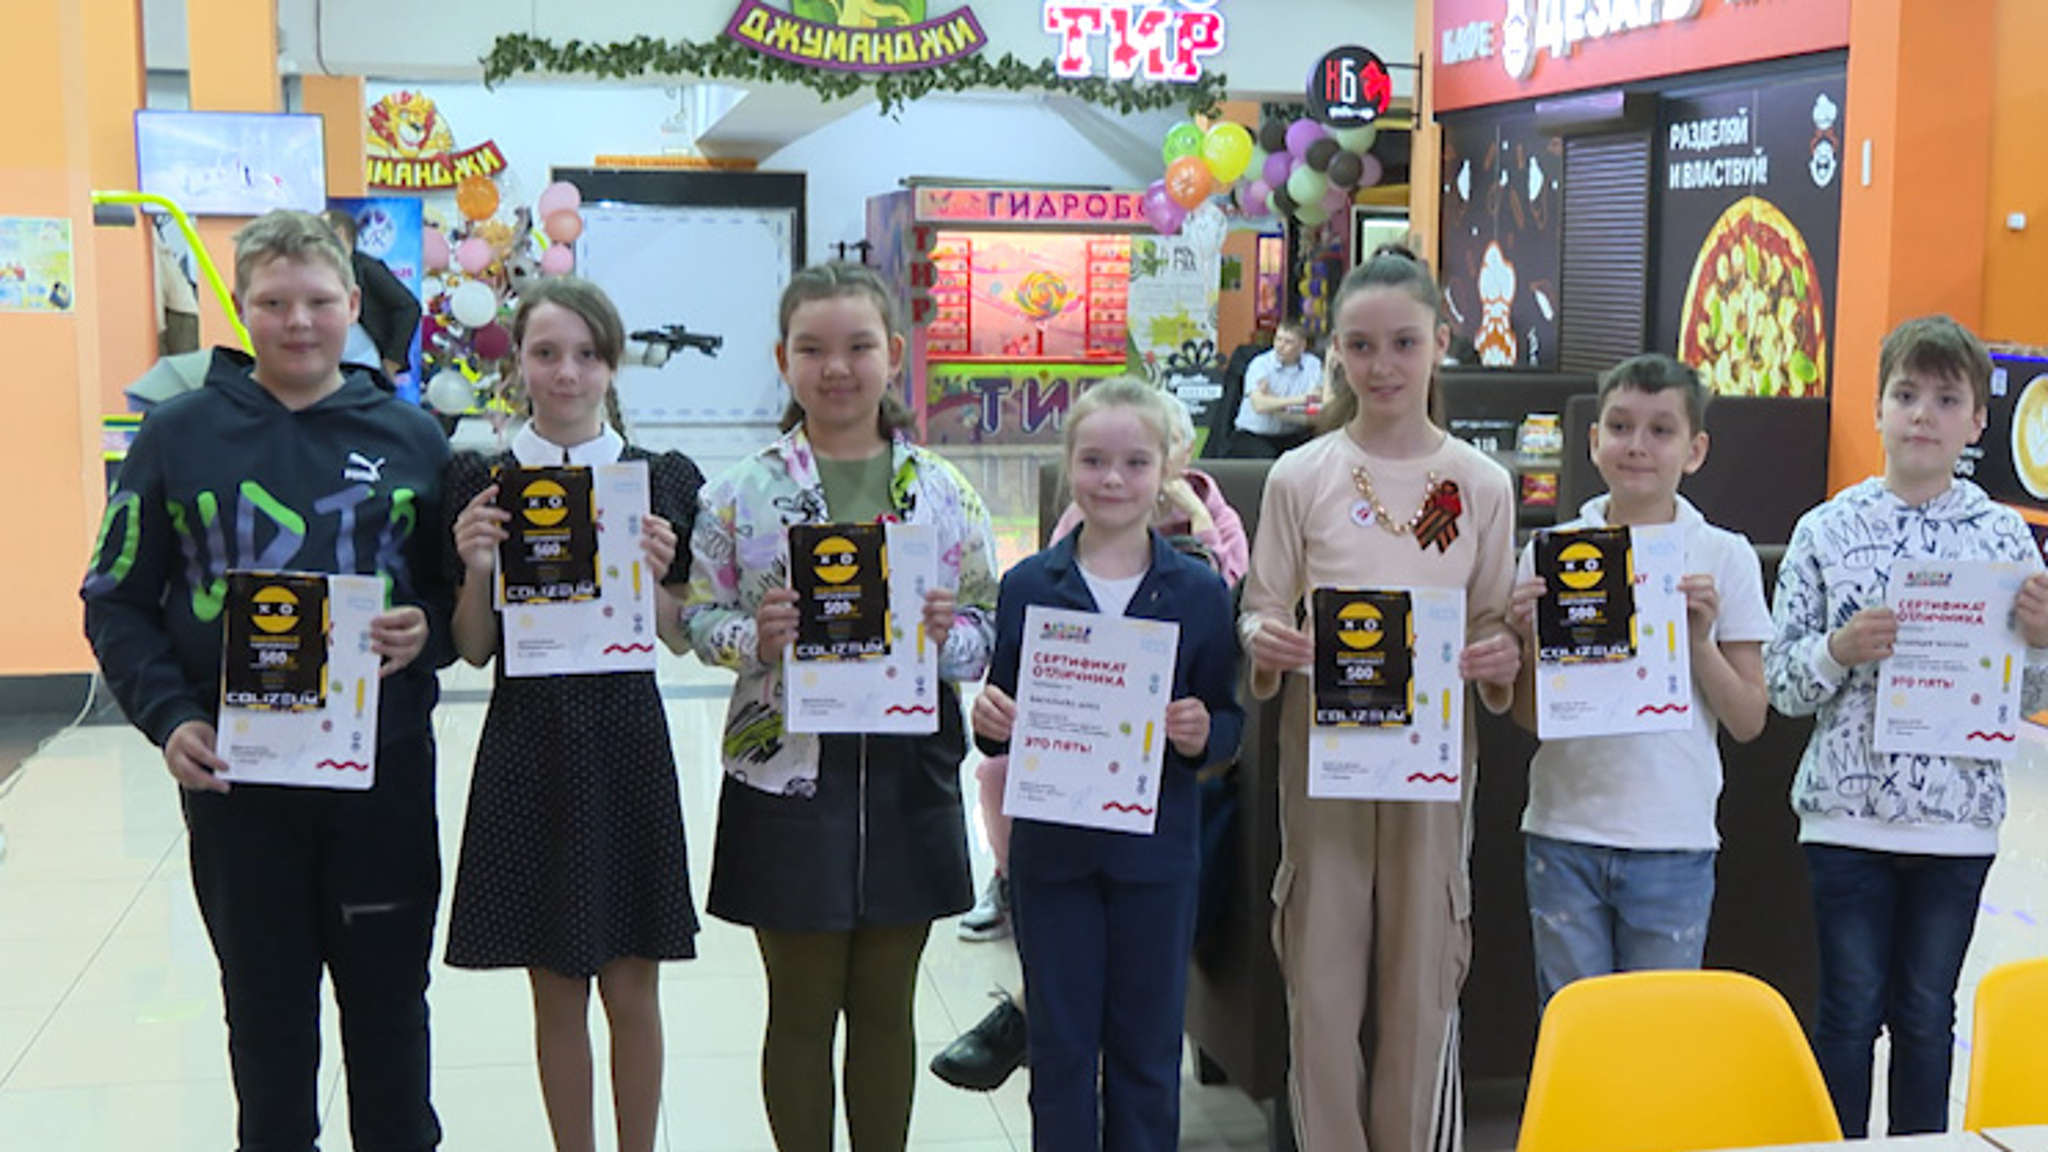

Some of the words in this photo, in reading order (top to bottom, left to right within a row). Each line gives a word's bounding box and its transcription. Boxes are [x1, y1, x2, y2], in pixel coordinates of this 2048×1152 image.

[738, 8, 977, 64] ДЖУМАНДЖИ
[1045, 5, 1222, 80] ТИР
[1669, 107, 1748, 152] РАЗДЕЛЯЙ
[367, 146, 500, 187] МАНДЖИ
[1669, 162, 1680, 189] И
[1682, 147, 1768, 190] ВЛАСТВУЙ!
[824, 601, 851, 614] 500
[1568, 607, 1596, 620] 500
[1899, 600, 1986, 612] СЕРТИФИКАТ
[1896, 610, 1985, 625] ОТЛИЧНИКА
[1033, 652, 1128, 673] СЕРТИФИКАТ
[1032, 665, 1126, 688] ОТЛИЧНИКА
[1346, 666, 1373, 679] 500
[1891, 676, 1916, 688] ЭТО
[1025, 736, 1050, 750] ЭТО
[1053, 738, 1092, 753] ПЯТЬ!
